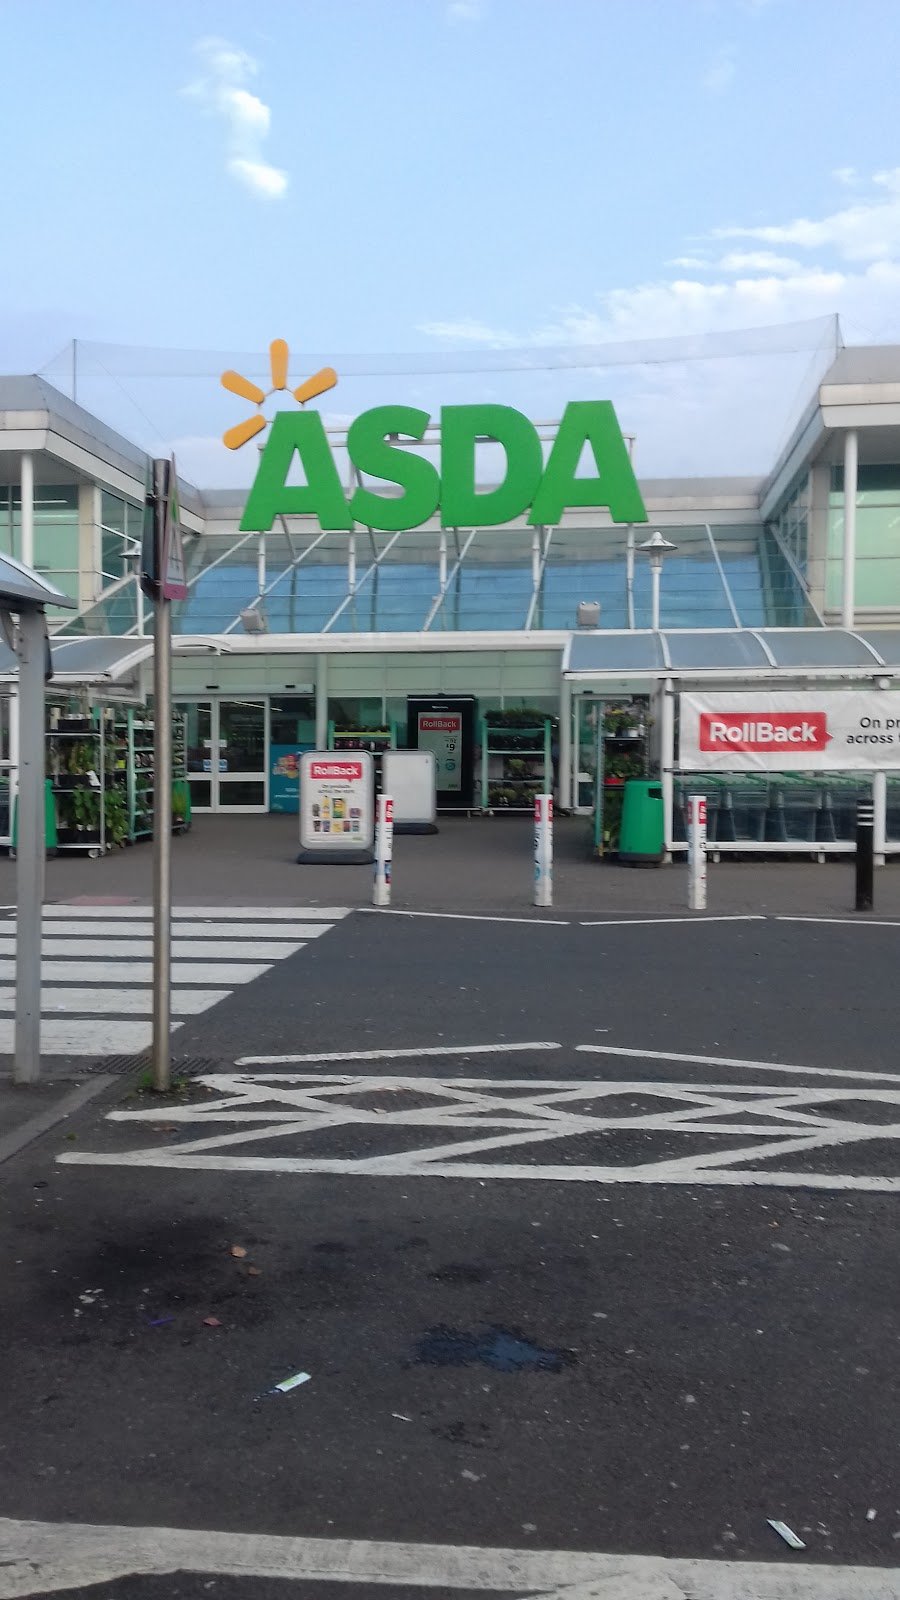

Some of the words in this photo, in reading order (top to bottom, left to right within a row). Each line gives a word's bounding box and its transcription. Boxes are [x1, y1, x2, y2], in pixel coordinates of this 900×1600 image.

[239, 400, 648, 531] ASDA
[422, 720, 457, 729] RollBack
[860, 717, 881, 729] On
[709, 721, 818, 744] RollBack
[846, 734, 894, 744] across
[313, 765, 359, 776] RollBack
